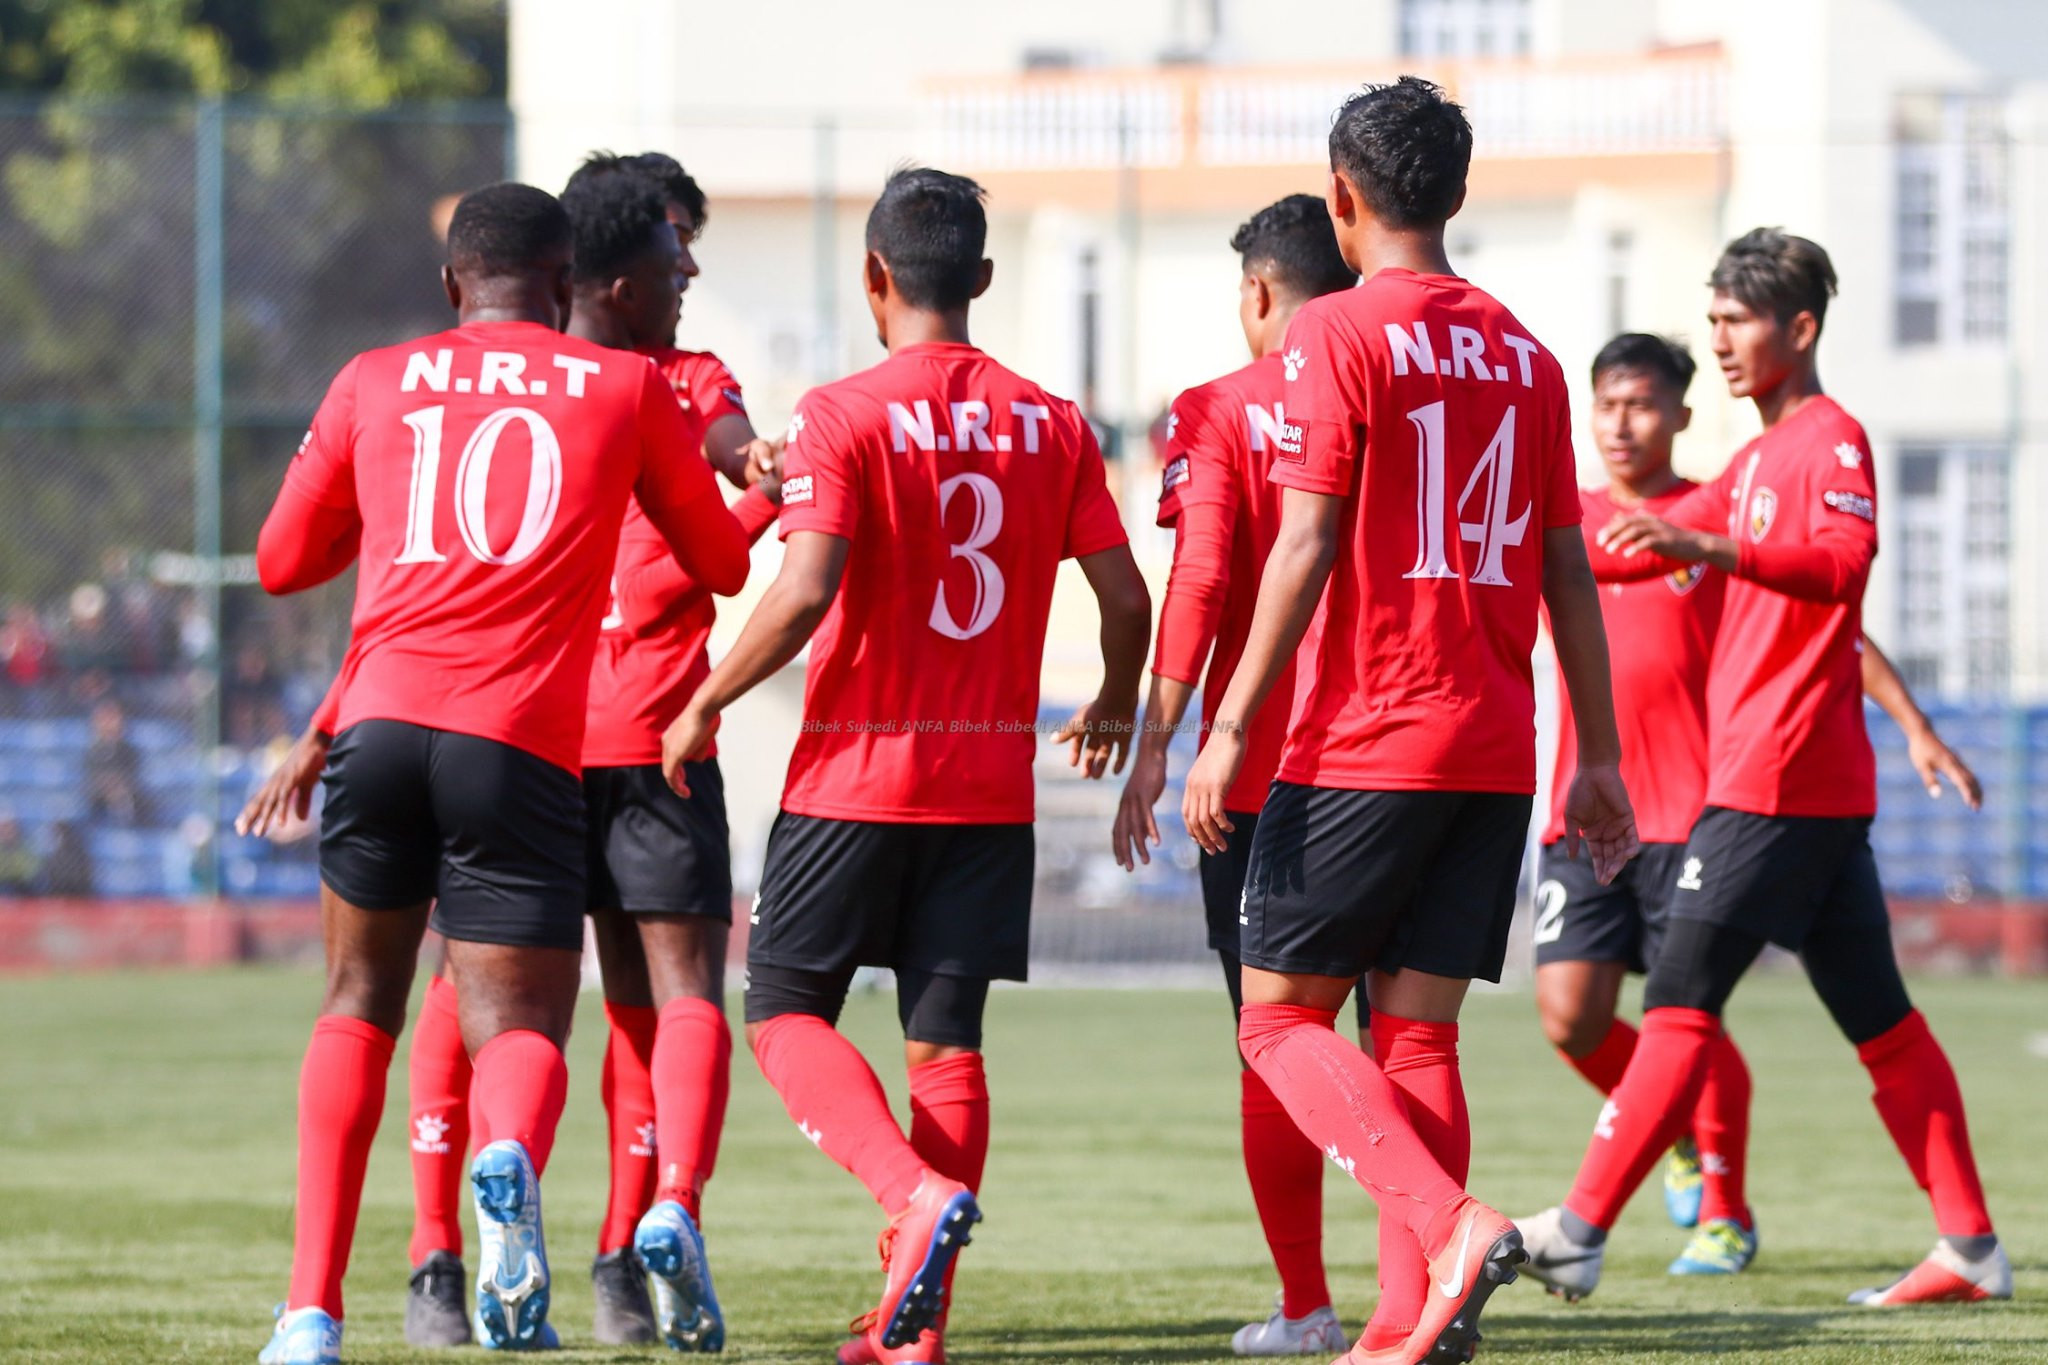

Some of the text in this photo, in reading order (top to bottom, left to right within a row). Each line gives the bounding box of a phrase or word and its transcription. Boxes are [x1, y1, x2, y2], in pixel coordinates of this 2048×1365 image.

[401, 349, 600, 398] N.R.T
[1384, 321, 1538, 388] N.R.T
[887, 399, 1049, 454] N.R.T
[1246, 402, 1285, 452] N
[1282, 424, 1303, 443] TAR
[394, 404, 563, 566] 10
[1402, 400, 1532, 587] 14
[928, 472, 1006, 640] 3
[1535, 880, 1567, 945] 2
